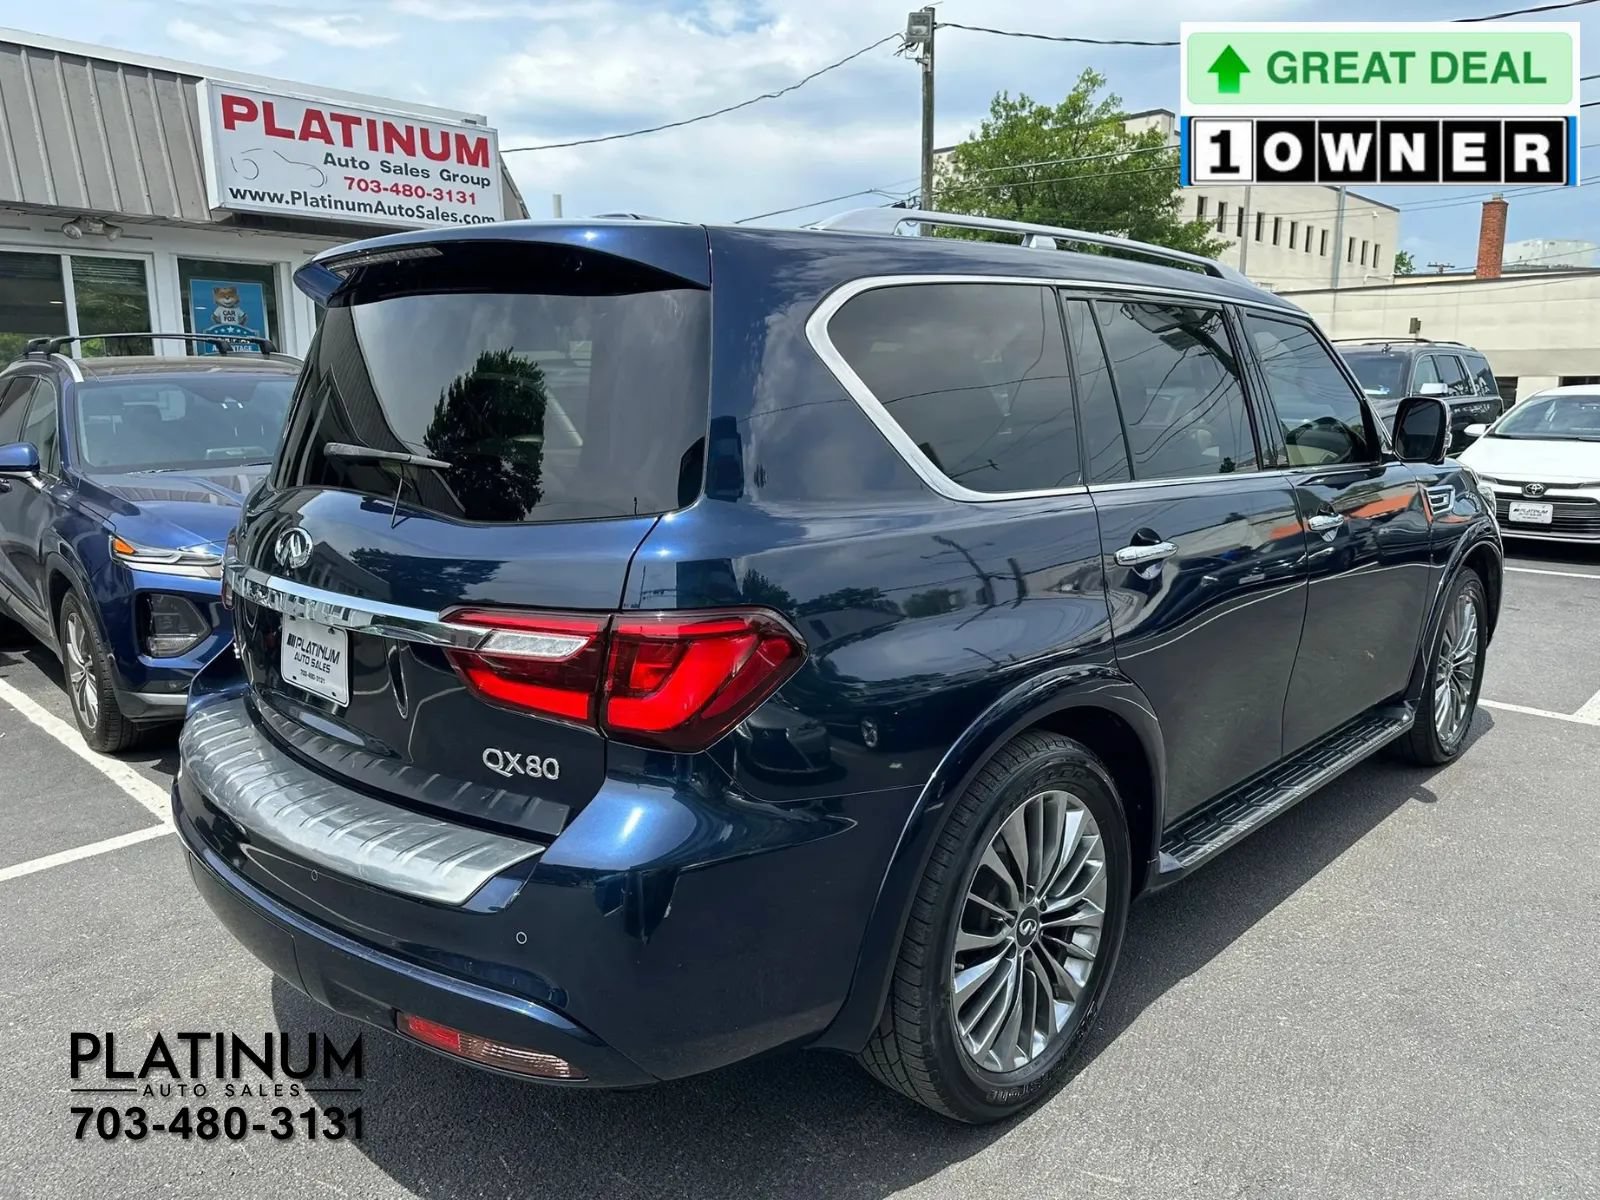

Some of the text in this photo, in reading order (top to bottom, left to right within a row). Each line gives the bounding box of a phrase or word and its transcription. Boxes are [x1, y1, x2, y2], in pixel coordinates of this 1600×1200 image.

[221, 94, 490, 169] PLATINUM
[323, 152, 491, 189] Auto Sales Group
[229, 187, 495, 225] www.PlatinumAutoSales.com
[344, 176, 476, 205] 703-480-3131
[294, 652, 331, 674] AUTO SALES
[295, 636, 341, 665] PLATINUM
[482, 747, 560, 780] QX80
